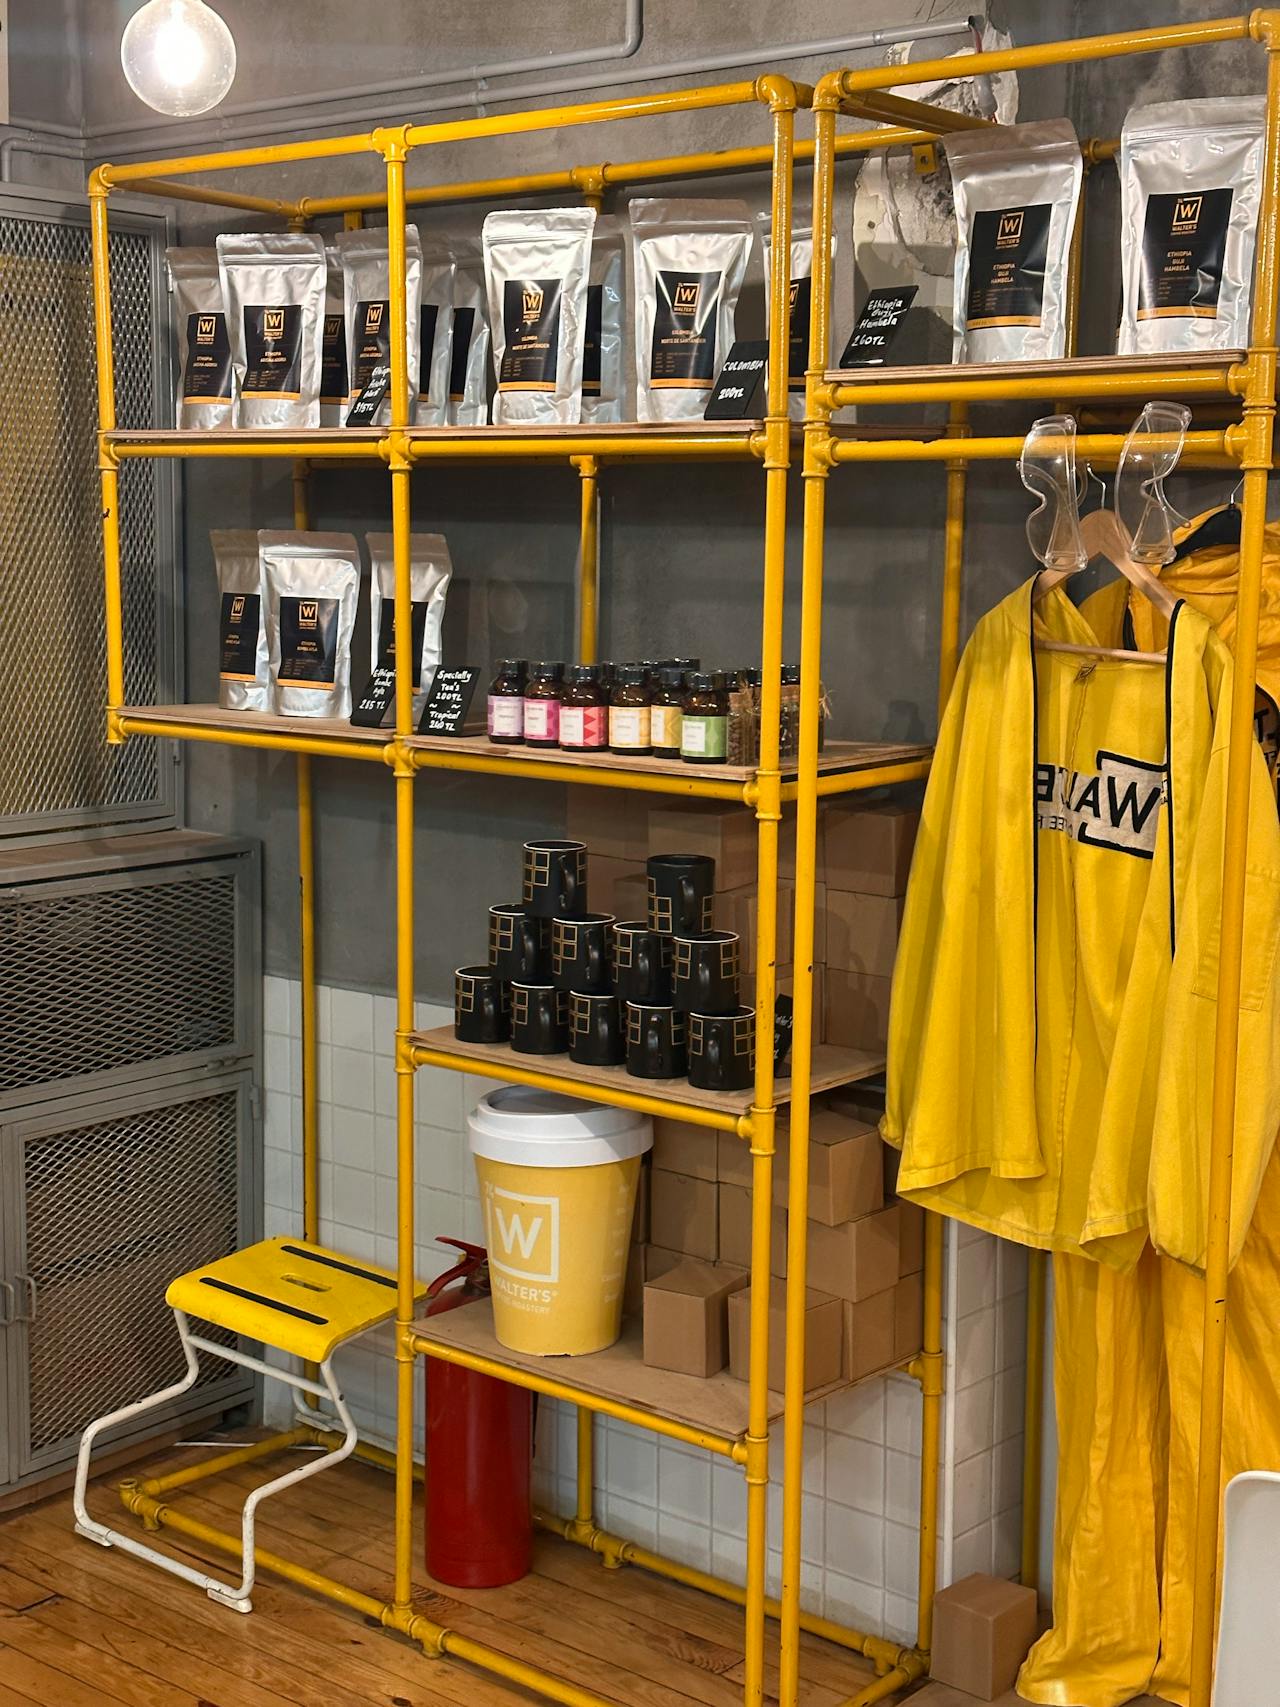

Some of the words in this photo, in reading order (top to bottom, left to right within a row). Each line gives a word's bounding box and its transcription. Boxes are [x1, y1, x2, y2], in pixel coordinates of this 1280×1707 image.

[1181, 203, 1198, 218] W
[1004, 218, 1019, 233] W
[1167, 250, 1192, 258] ETHIOPIA
[993, 263, 1016, 271] ETHIOPIA
[526, 294, 540, 308] W
[681, 288, 696, 302] W
[867, 299, 903, 310] Ethiopia
[268, 314, 281, 327] W
[370, 308, 380, 321] W
[201, 321, 213, 333] W
[723, 360, 764, 372] COLOMBIA
[718, 387, 744, 400] 200TL
[302, 606, 315, 618] W
[429, 710, 461, 722] Tropical
[445, 722, 456, 731] TL
[494, 1206, 544, 1260] W
[494, 1274, 553, 1304] WALTER'S
